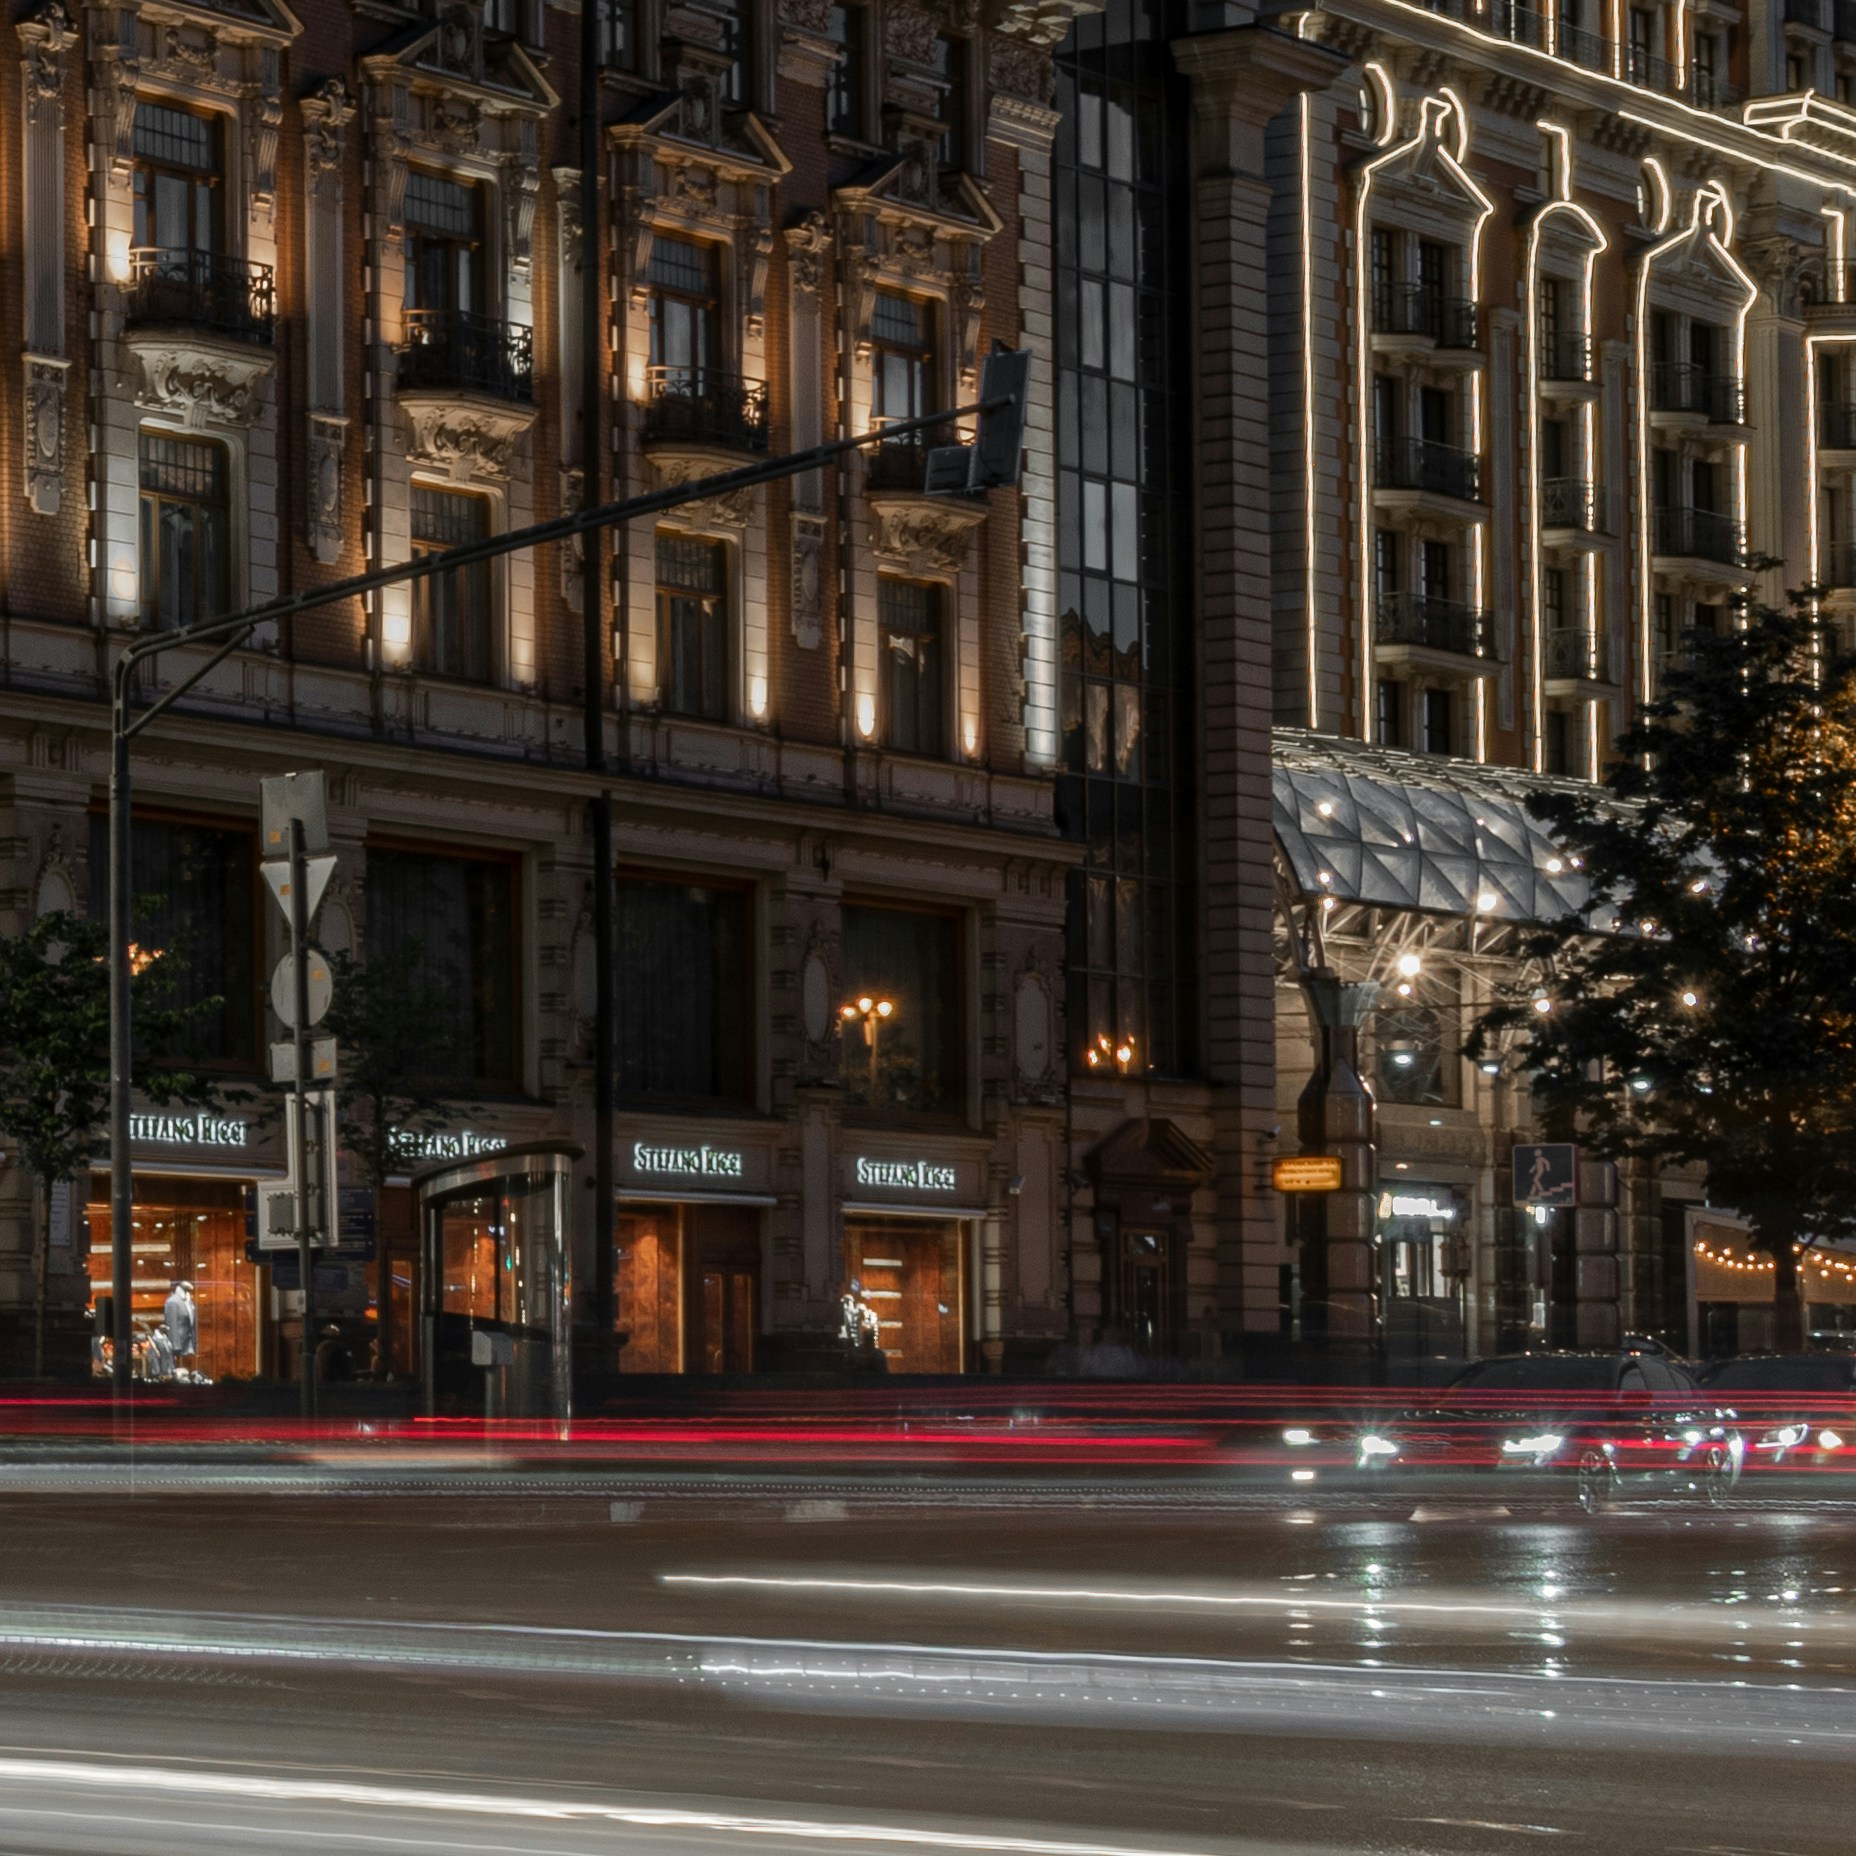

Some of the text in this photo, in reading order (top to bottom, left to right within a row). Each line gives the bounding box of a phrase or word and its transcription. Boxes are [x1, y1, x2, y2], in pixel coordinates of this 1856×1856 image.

[129, 1114, 194, 1143] TEFANO
[633, 1142, 742, 1176] STEFANO RICCI
[856, 1157, 956, 1190] STEFANO RICCI
